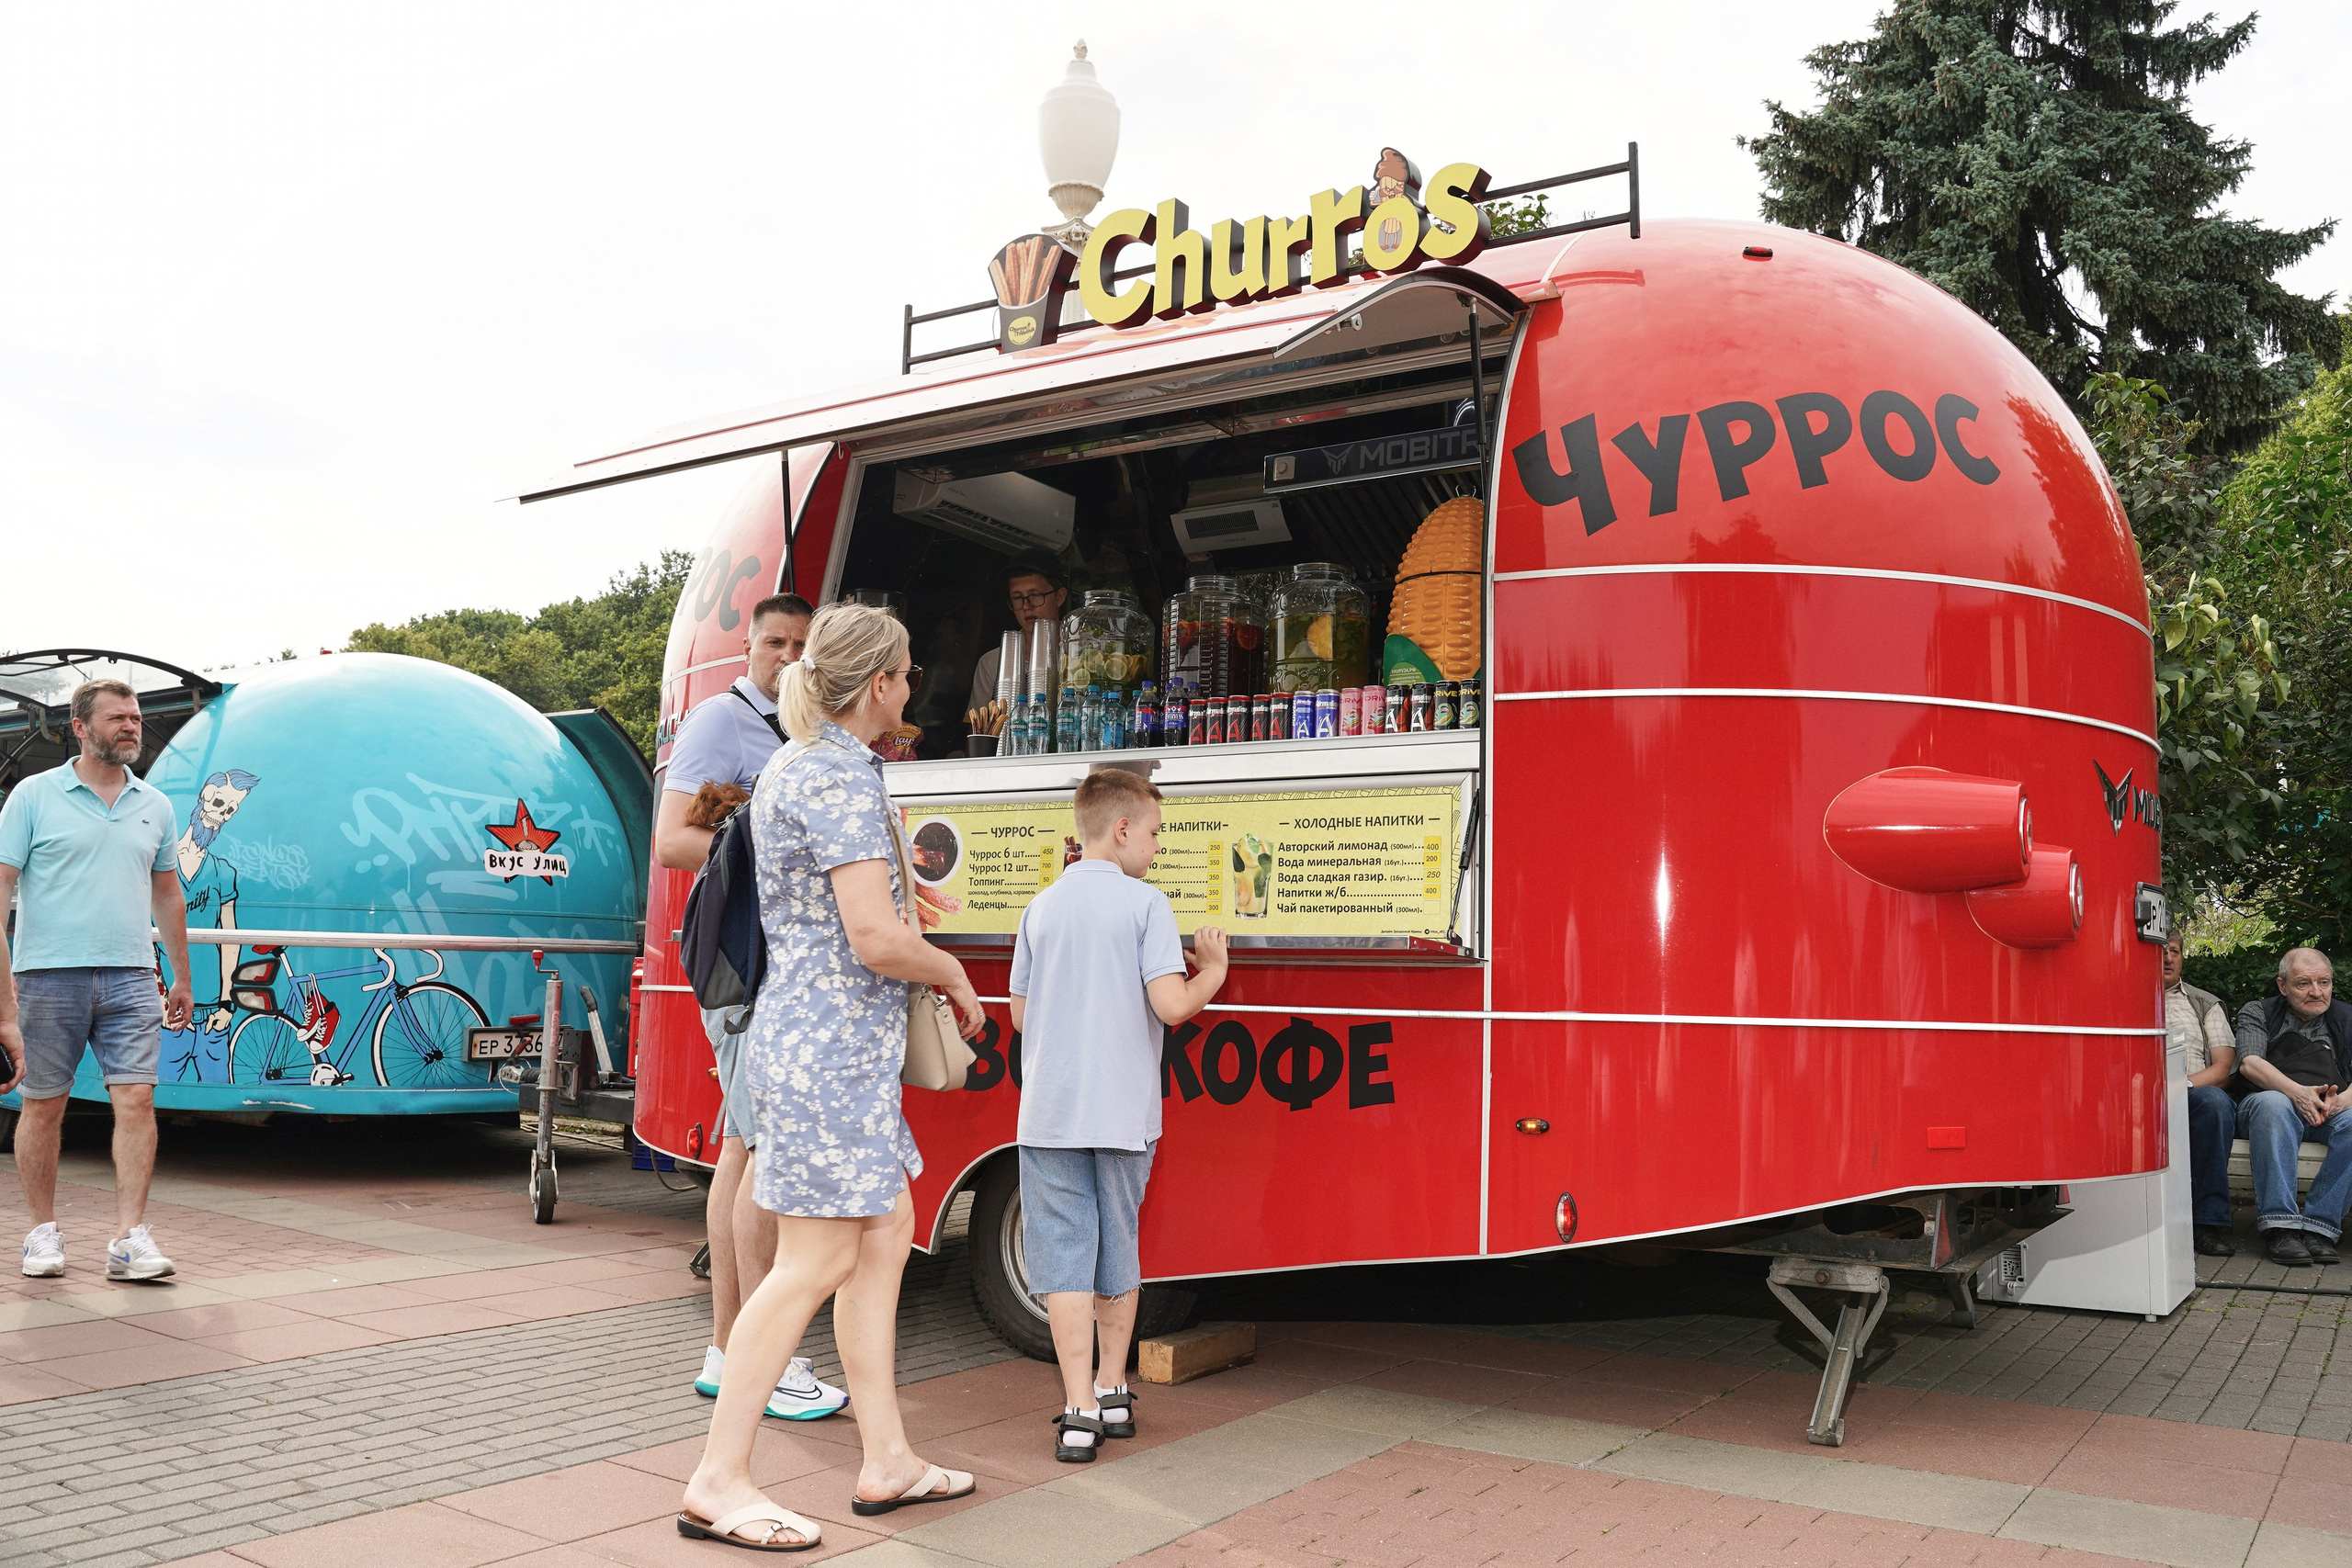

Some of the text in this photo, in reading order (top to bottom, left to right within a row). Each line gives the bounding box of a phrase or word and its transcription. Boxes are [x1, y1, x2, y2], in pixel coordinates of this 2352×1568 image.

[1079, 162, 1488, 327] Churros
[1512, 390, 2001, 536] ЧУРРОС
[1170, 821, 1221, 832] НАПИТКИ
[1294, 815, 1424, 830] ХОЛОДНЫЕ НАПИТКИ
[990, 826, 1035, 838] ЧУРРОС
[1278, 840, 1334, 853] Авторский
[1337, 841, 1388, 852] лимонад
[969, 850, 1001, 861] Чуррос
[1003, 847, 1010, 858] 6
[969, 863, 1001, 874] Чуррос
[1003, 863, 1012, 872] 12
[1278, 857, 1304, 869] Вода
[1306, 858, 1382, 868] минеральная
[1277, 873, 1304, 884] Вода
[1306, 874, 1351, 884] сладкая
[1353, 874, 1387, 883] газир.
[1277, 887, 1322, 897] Напитки
[1325, 886, 1347, 899] ж/б
[1277, 902, 1296, 913] Чай
[1299, 902, 1393, 915] пакетированный
[1161, 1015, 1396, 1112] КОФЕ
